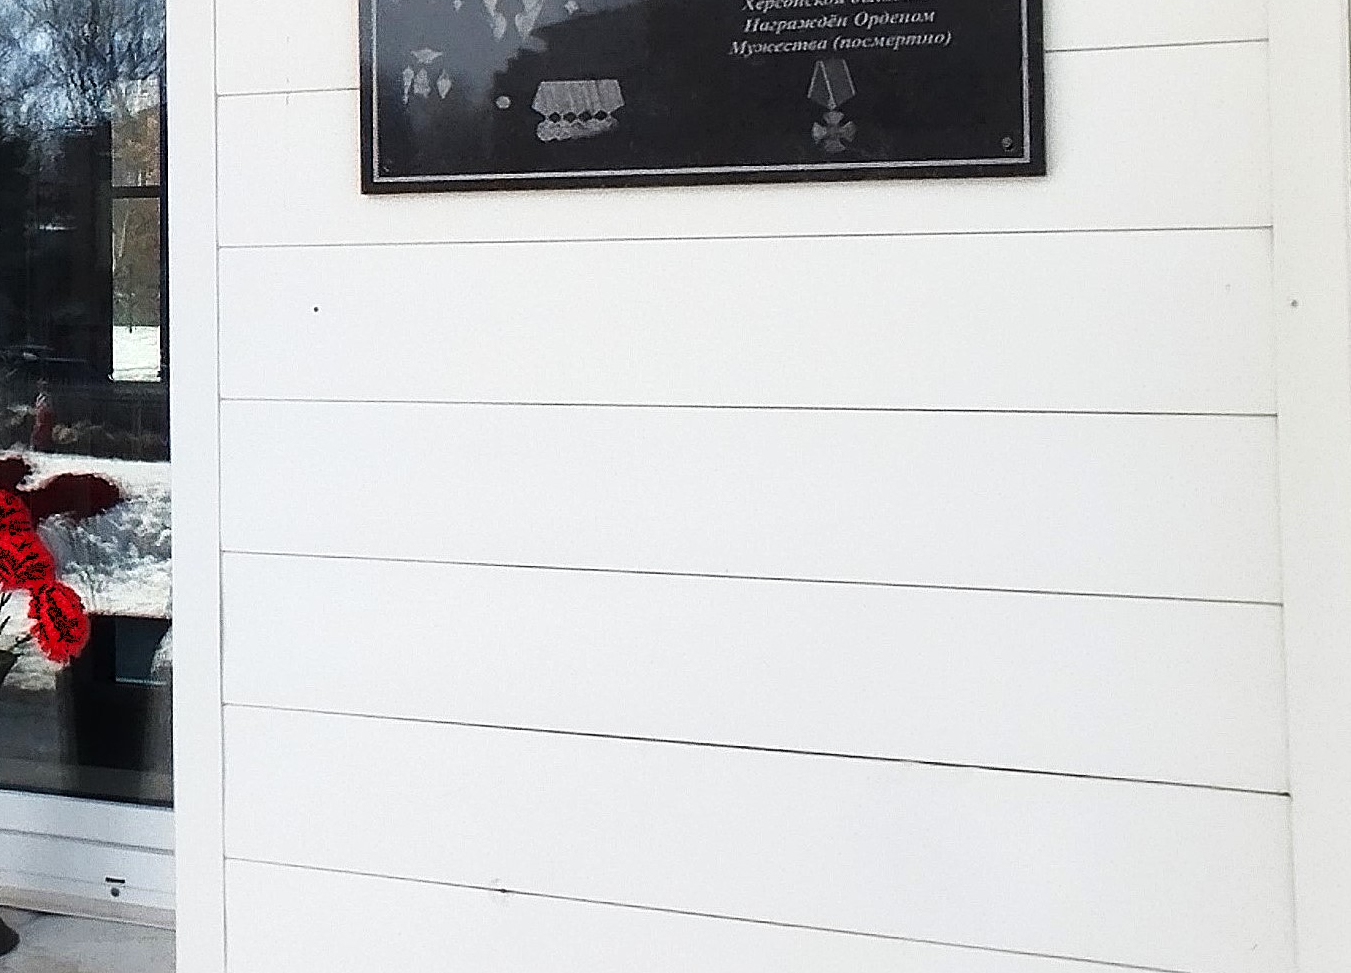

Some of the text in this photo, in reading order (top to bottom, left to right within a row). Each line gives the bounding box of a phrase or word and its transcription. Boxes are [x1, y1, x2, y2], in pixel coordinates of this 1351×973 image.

[743, 9, 936, 35] Награждён Орденом
[728, 30, 952, 57] Мужества (посмертно)
